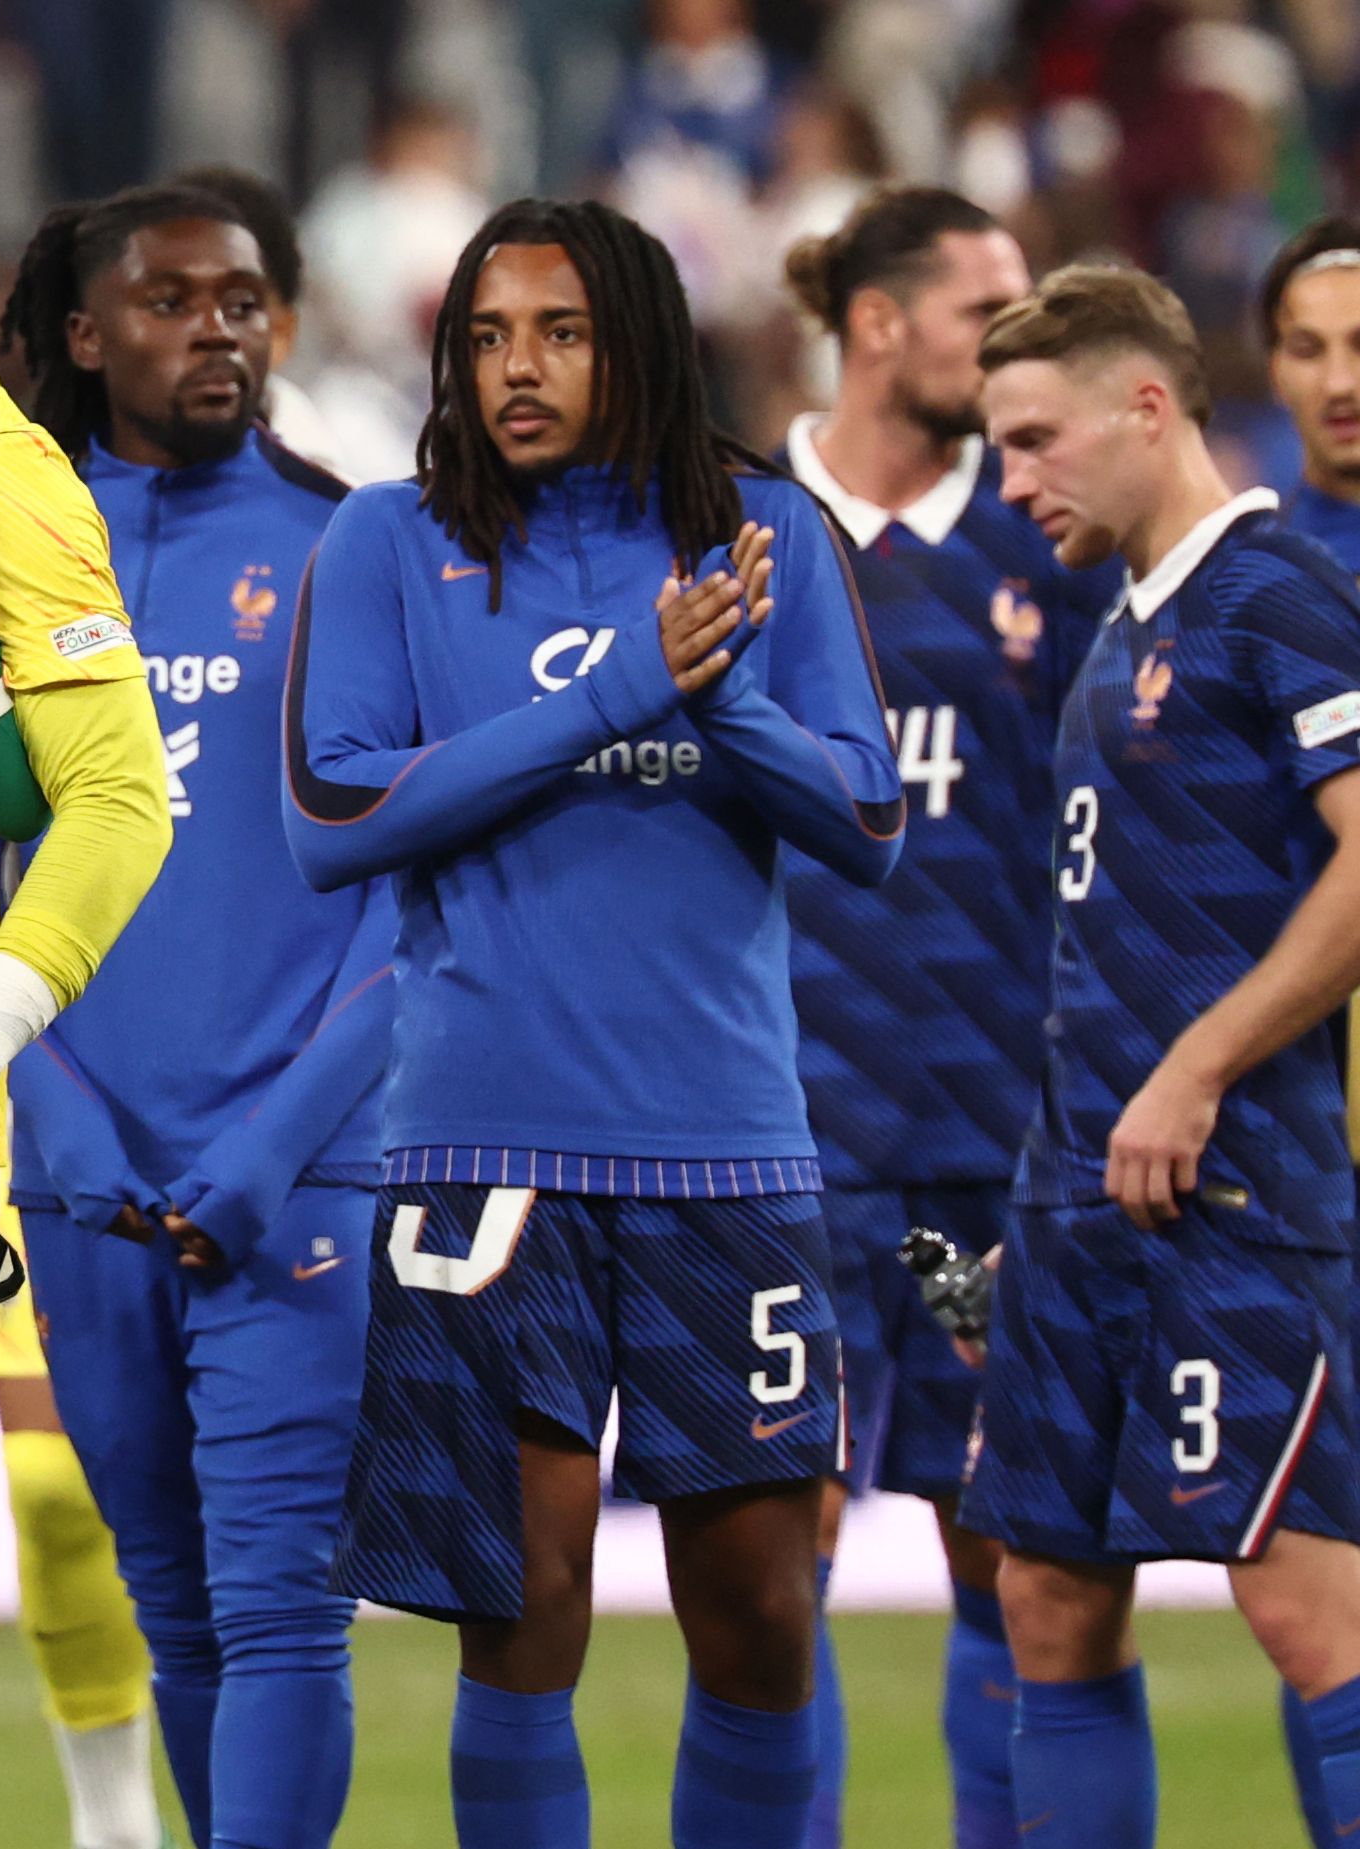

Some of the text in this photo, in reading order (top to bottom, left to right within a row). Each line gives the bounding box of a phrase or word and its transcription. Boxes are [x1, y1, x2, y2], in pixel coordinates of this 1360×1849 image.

[53, 626, 76, 641] UEFA
[1058, 785, 1098, 901] 3
[749, 1284, 807, 1404] 5
[1170, 1358, 1222, 1474] 3
